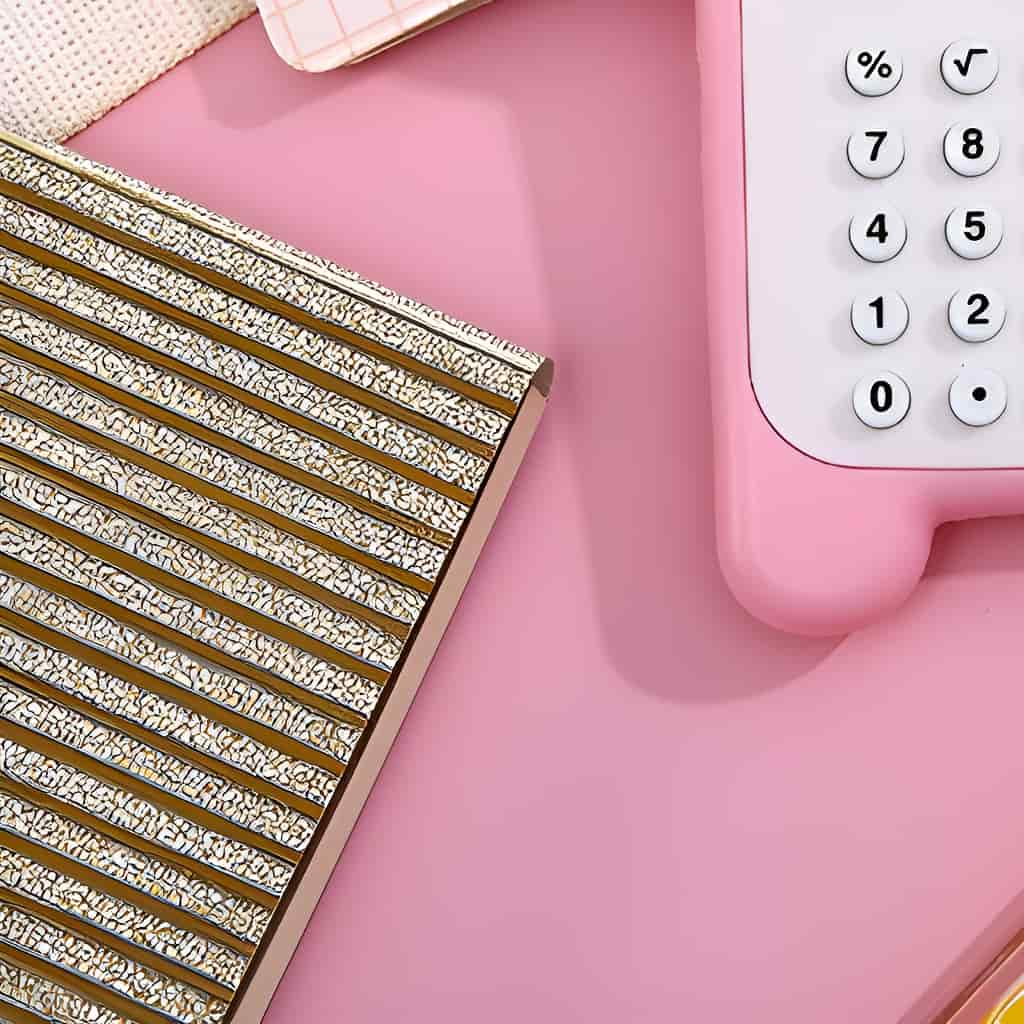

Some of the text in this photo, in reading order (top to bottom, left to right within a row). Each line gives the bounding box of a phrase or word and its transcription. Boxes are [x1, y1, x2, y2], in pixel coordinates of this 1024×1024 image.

[856, 49, 894, 80] %
[863, 130, 889, 163] 7
[961, 126, 985, 161] 8
[865, 212, 890, 245] 4
[962, 209, 987, 243] 5
[867, 295, 885, 330] 1
[966, 292, 991, 326] 2
[869, 379, 894, 414] 0
